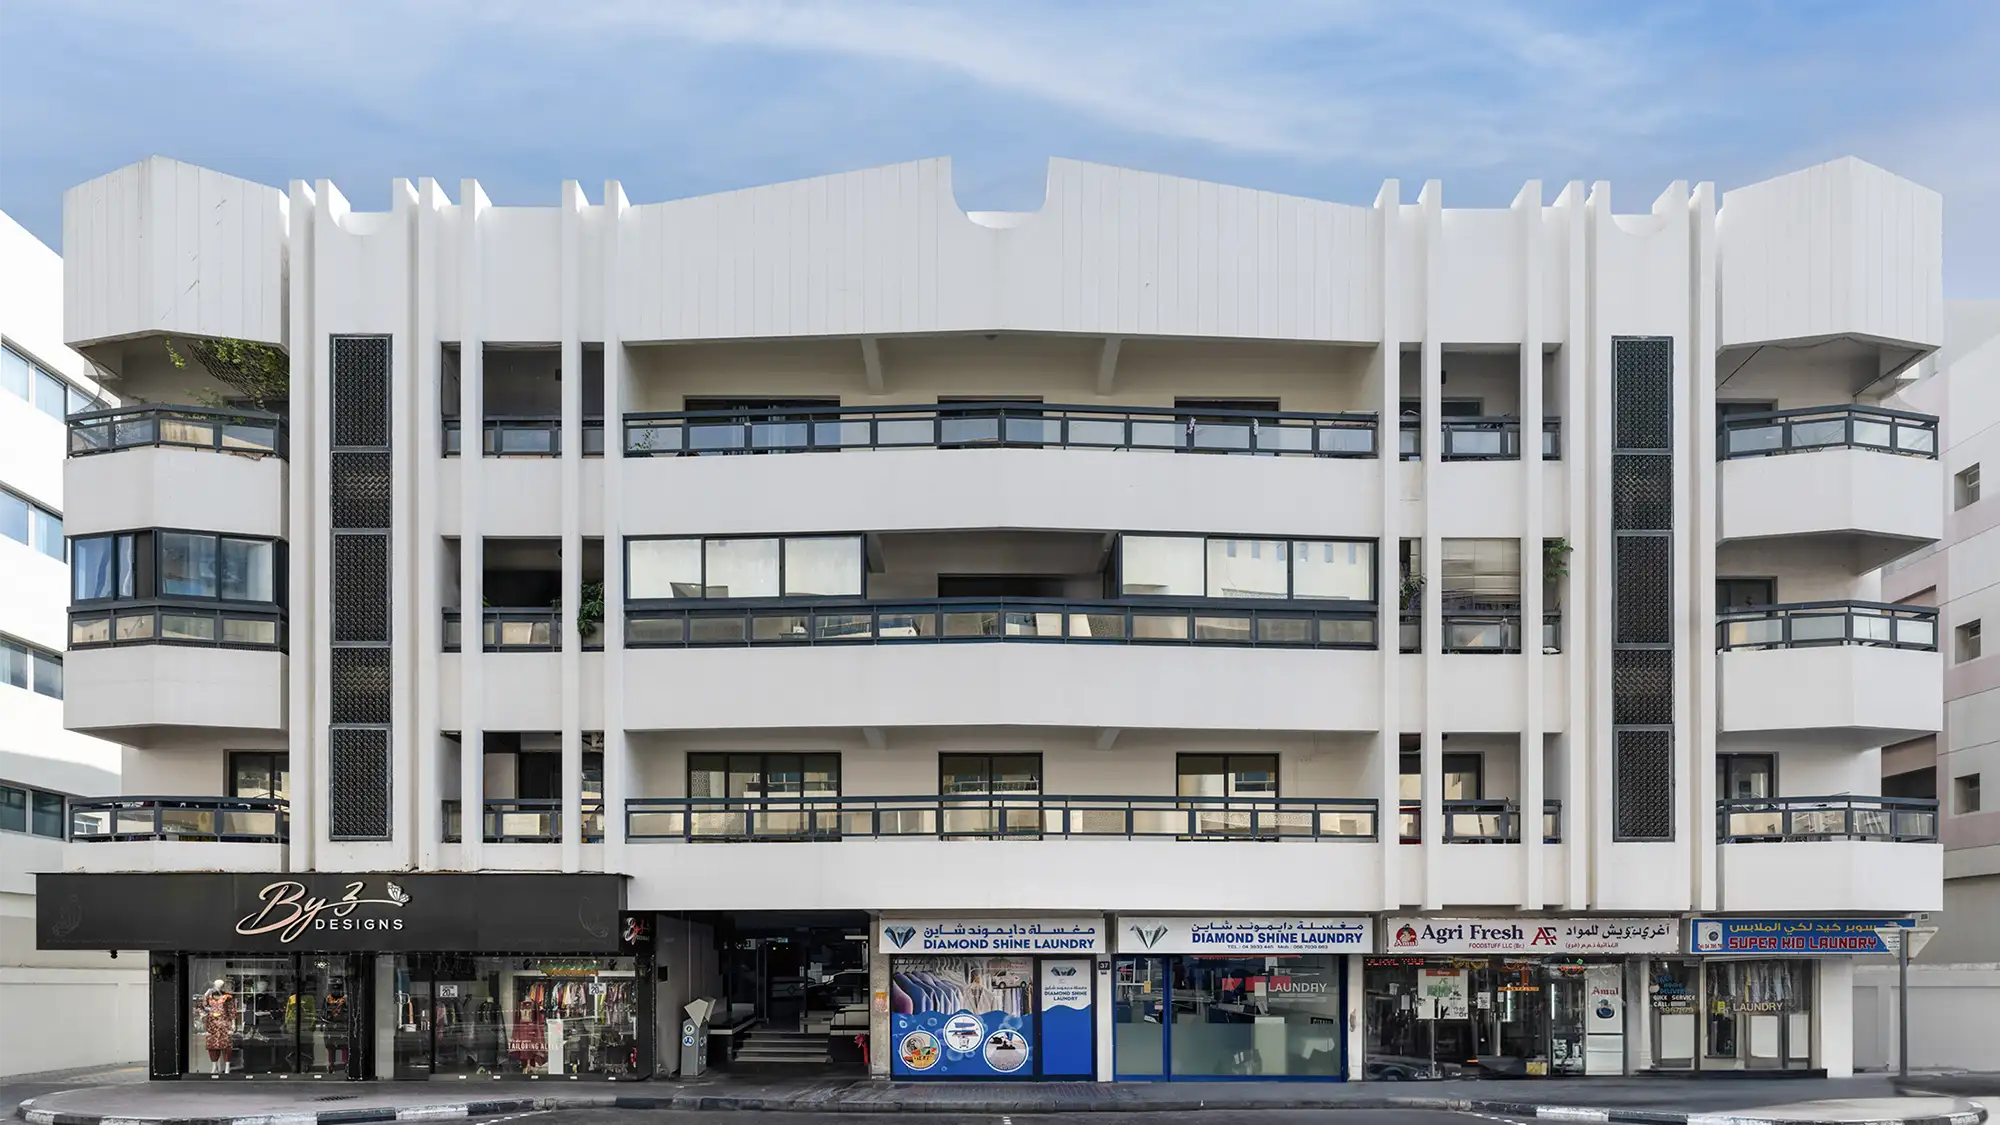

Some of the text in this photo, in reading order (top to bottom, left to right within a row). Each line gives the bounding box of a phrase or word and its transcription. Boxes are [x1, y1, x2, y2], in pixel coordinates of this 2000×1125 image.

[235, 881, 327, 943] By
[315, 918, 404, 930] DESIGNS
[1191, 920, 1364, 933] مغسلة دايموند شاين
[1729, 922, 1781, 933] الملابس
[1783, 922, 1813, 935] لكي
[1815, 922, 1841, 933] كيد
[923, 922, 1096, 938] مغسلة دايموند شاين
[1421, 924, 1524, 944] Agri Fresh
[1192, 932, 1363, 943] DIAMOND SHINE LAUNDRY
[1729, 937, 1778, 949] SUPER
[1782, 937, 1805, 949] KID
[1809, 937, 1877, 949] LAUNDRY
[924, 939, 1095, 949] DIAMOND SHINE LAUNDRY
[1591, 986, 1619, 996] Amul
[1733, 1003, 1784, 1012] LAUNDRY
[508, 1042, 539, 1050] TAILORING
